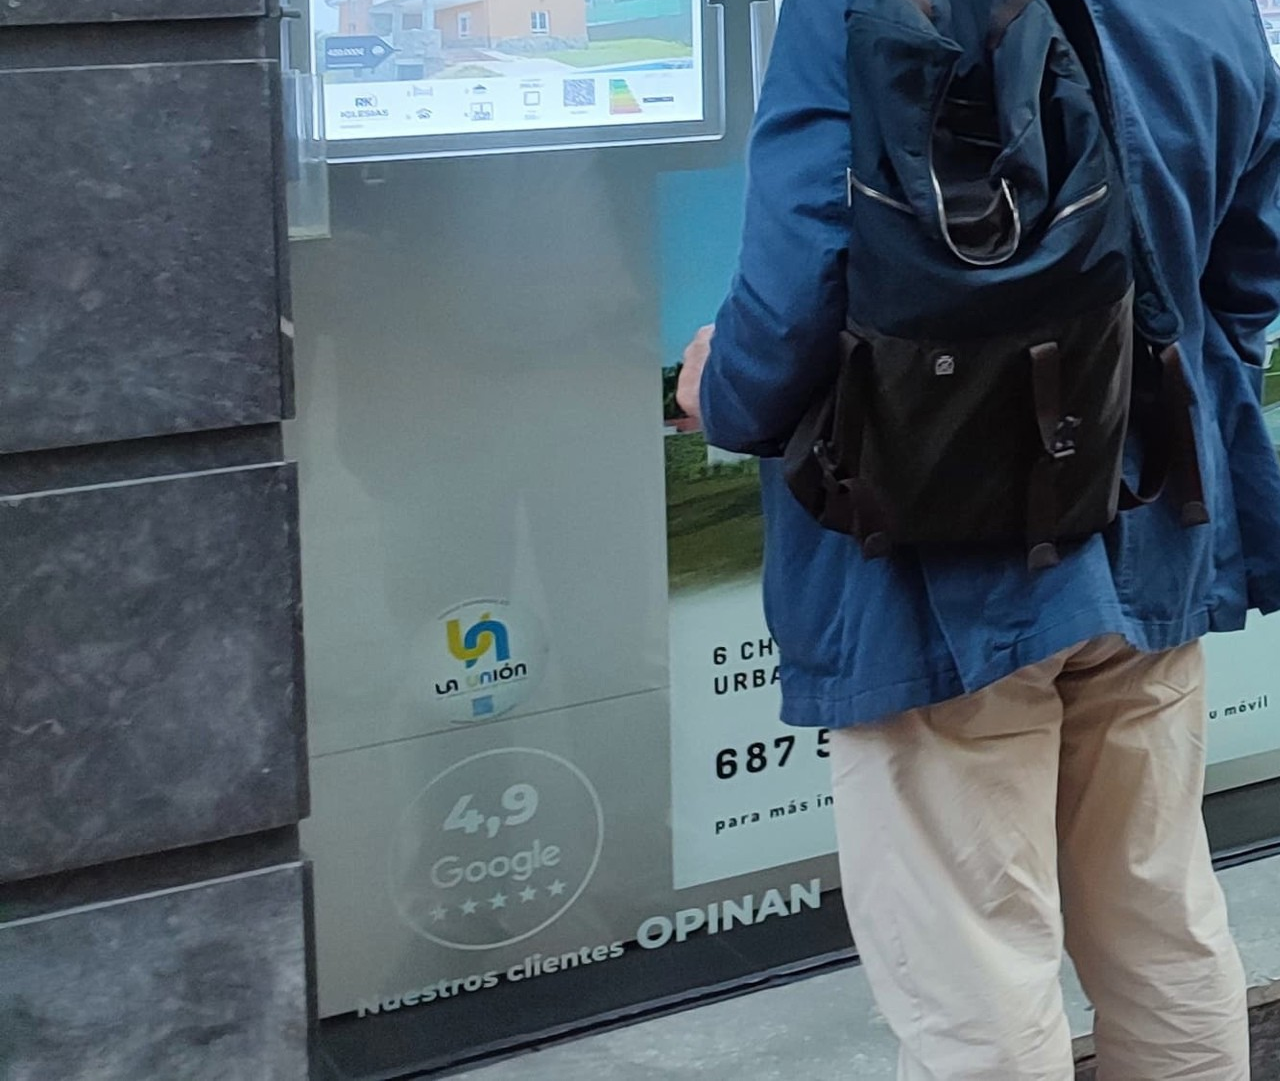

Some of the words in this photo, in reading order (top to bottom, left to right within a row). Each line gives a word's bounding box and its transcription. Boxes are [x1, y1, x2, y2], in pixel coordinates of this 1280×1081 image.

[713, 646, 727, 665] 6
[714, 665, 782, 695] URBA
[1224, 695, 1269, 717] móvil
[716, 735, 795, 780] 687
[816, 728, 830, 758] 5
[443, 783, 539, 838] 4,9
[715, 812, 760, 835] para
[769, 800, 808, 819] más
[816, 793, 834, 808] in
[431, 839, 561, 888] Google
[356, 970, 499, 1017] Nuestros
[506, 940, 624, 982] clientes
[636, 878, 822, 950] OPINAN
